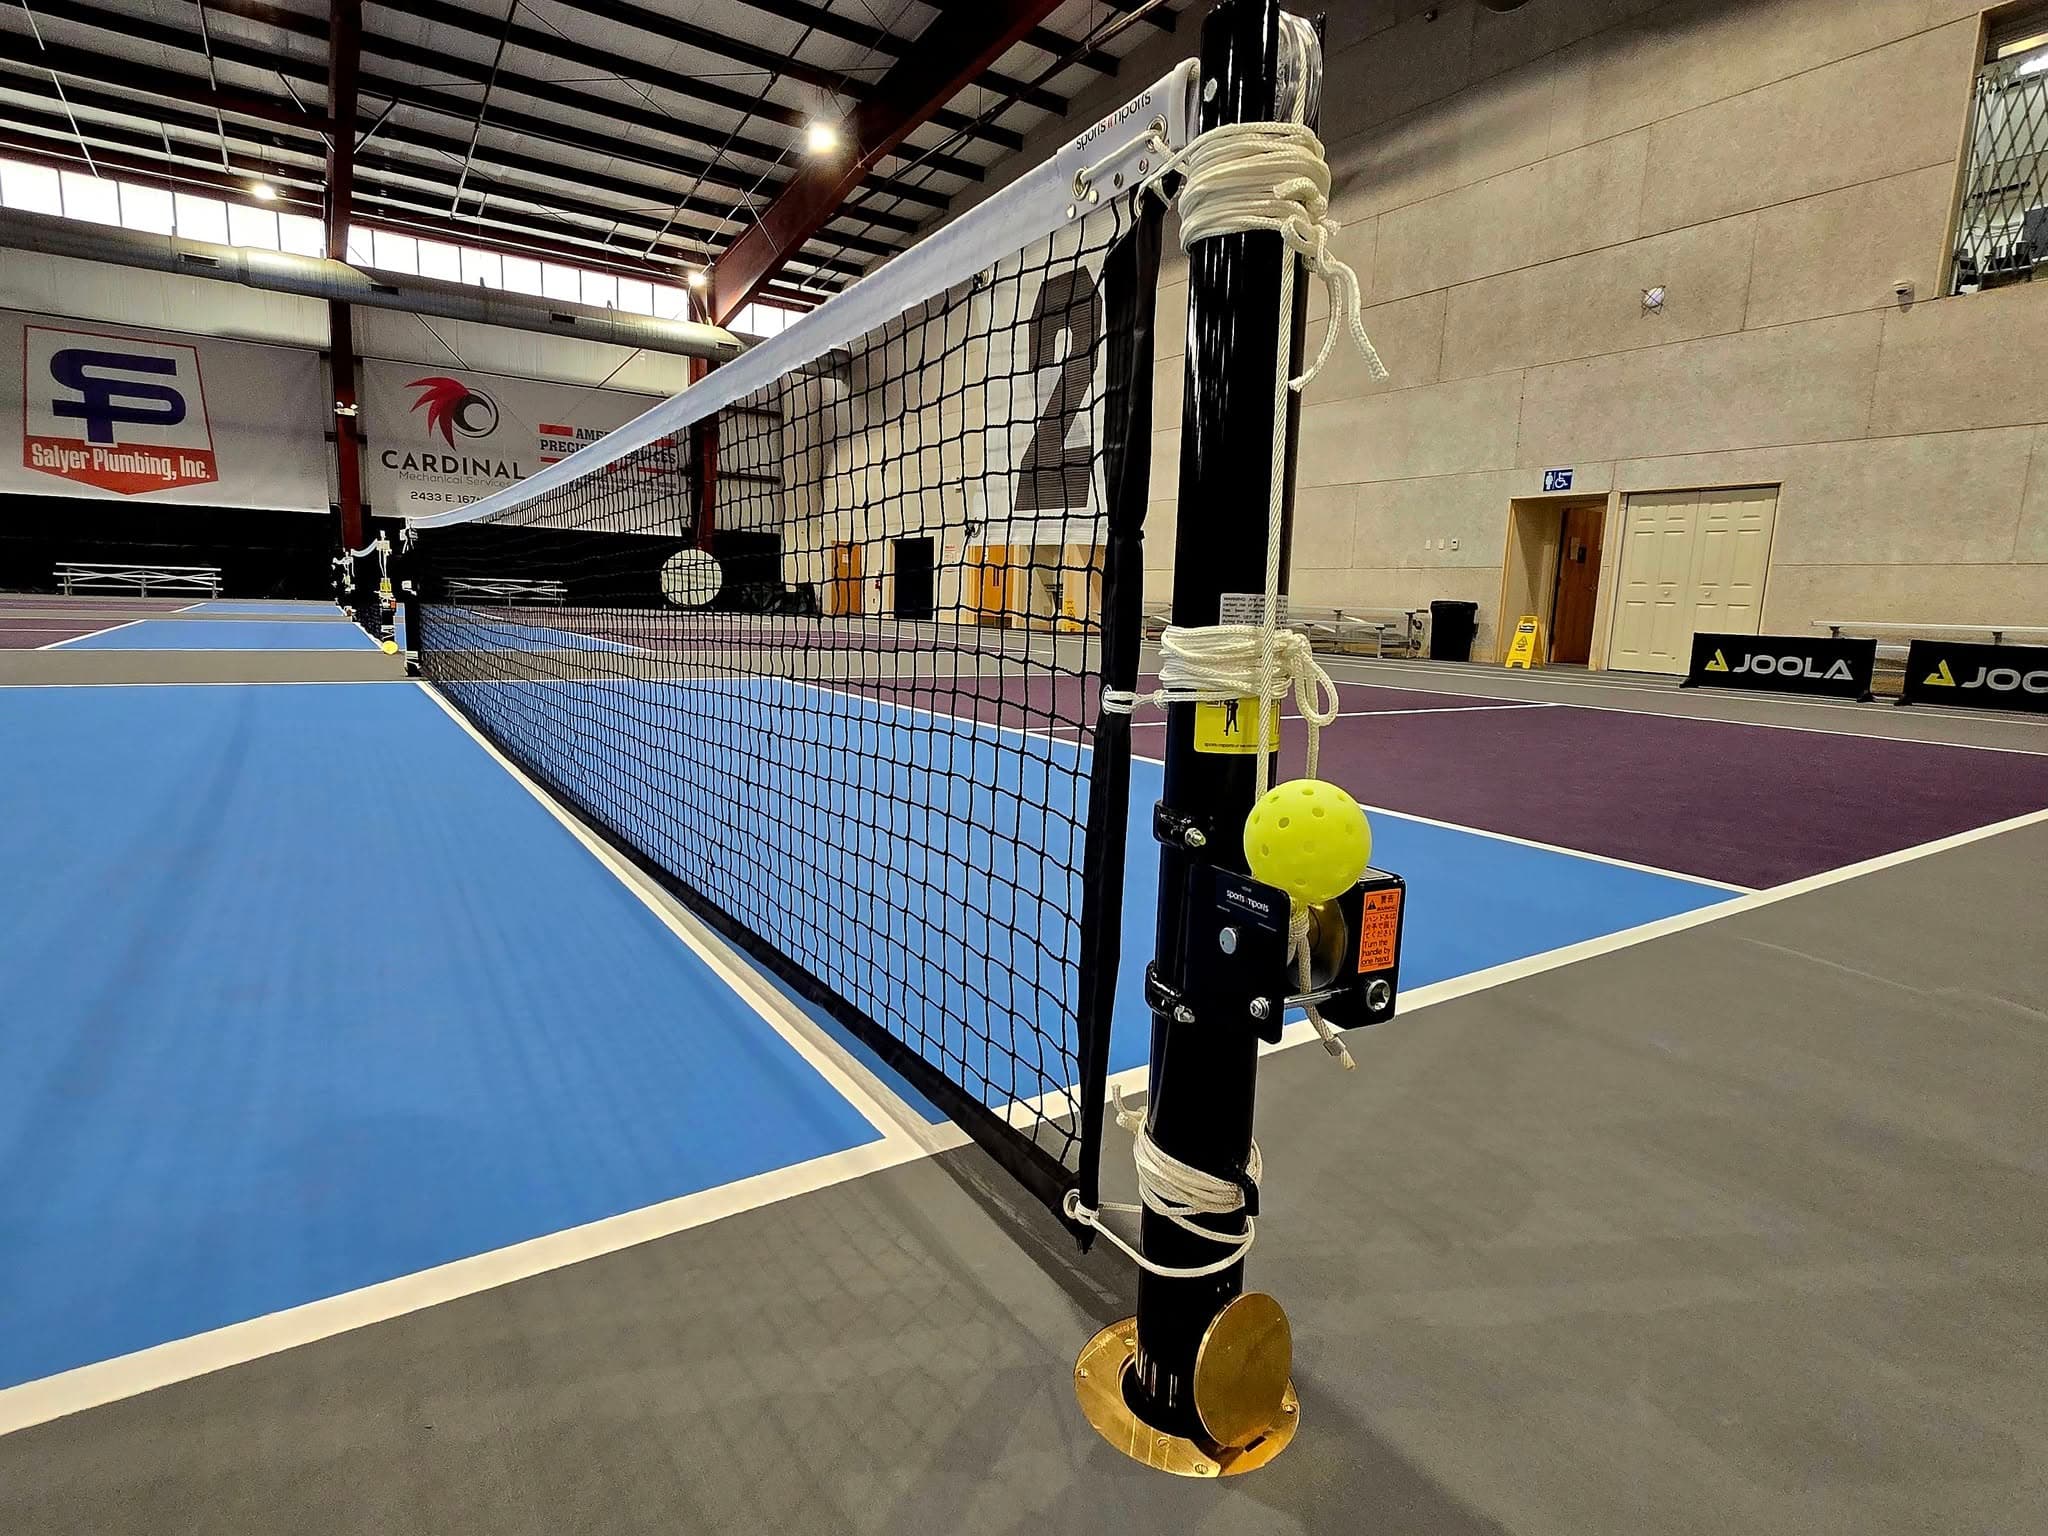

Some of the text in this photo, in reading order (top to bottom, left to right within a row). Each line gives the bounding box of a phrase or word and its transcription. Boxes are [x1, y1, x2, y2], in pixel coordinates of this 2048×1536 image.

[1014, 265, 1102, 511] 2
[32, 443, 210, 480] Salyer Plumbing, Inc.
[381, 450, 526, 480] CARDINAL
[399, 471, 512, 488] Mechanical Services
[410, 491, 443, 502] 2433
[445, 494, 456, 503] E.
[1732, 653, 1854, 681] JOOLA
[1362, 948, 1383, 958] handle
[1364, 941, 1378, 949] Turn
